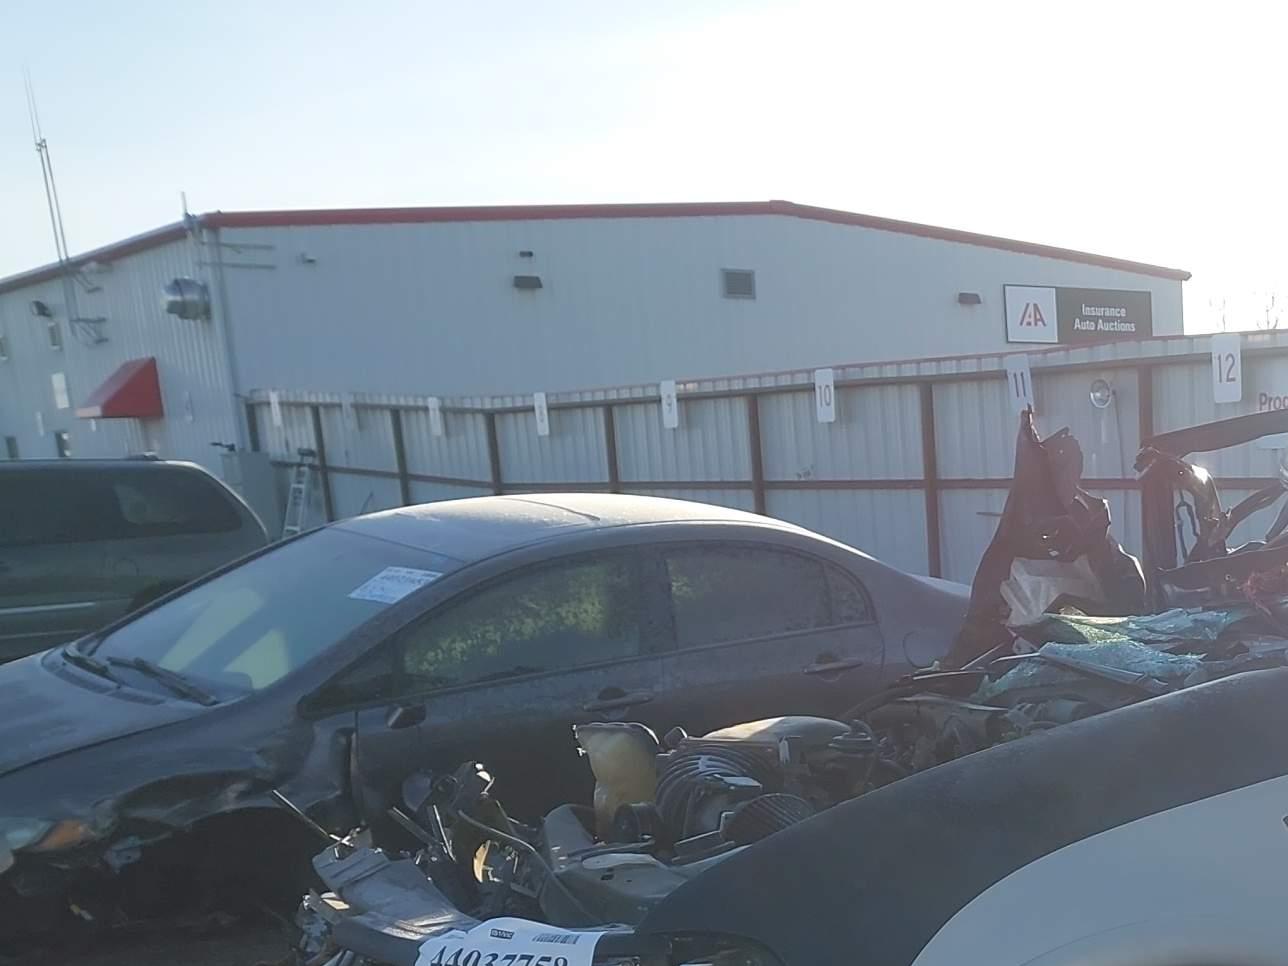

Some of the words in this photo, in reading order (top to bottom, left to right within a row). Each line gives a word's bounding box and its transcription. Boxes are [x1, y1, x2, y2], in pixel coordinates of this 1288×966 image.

[1082, 303, 1126, 318] Insurance
[1074, 318, 1096, 331] Auto
[1097, 318, 1136, 332] Auctions
[1217, 353, 1236, 384] 12
[818, 384, 832, 408] 10
[1014, 371, 1027, 399] 11
